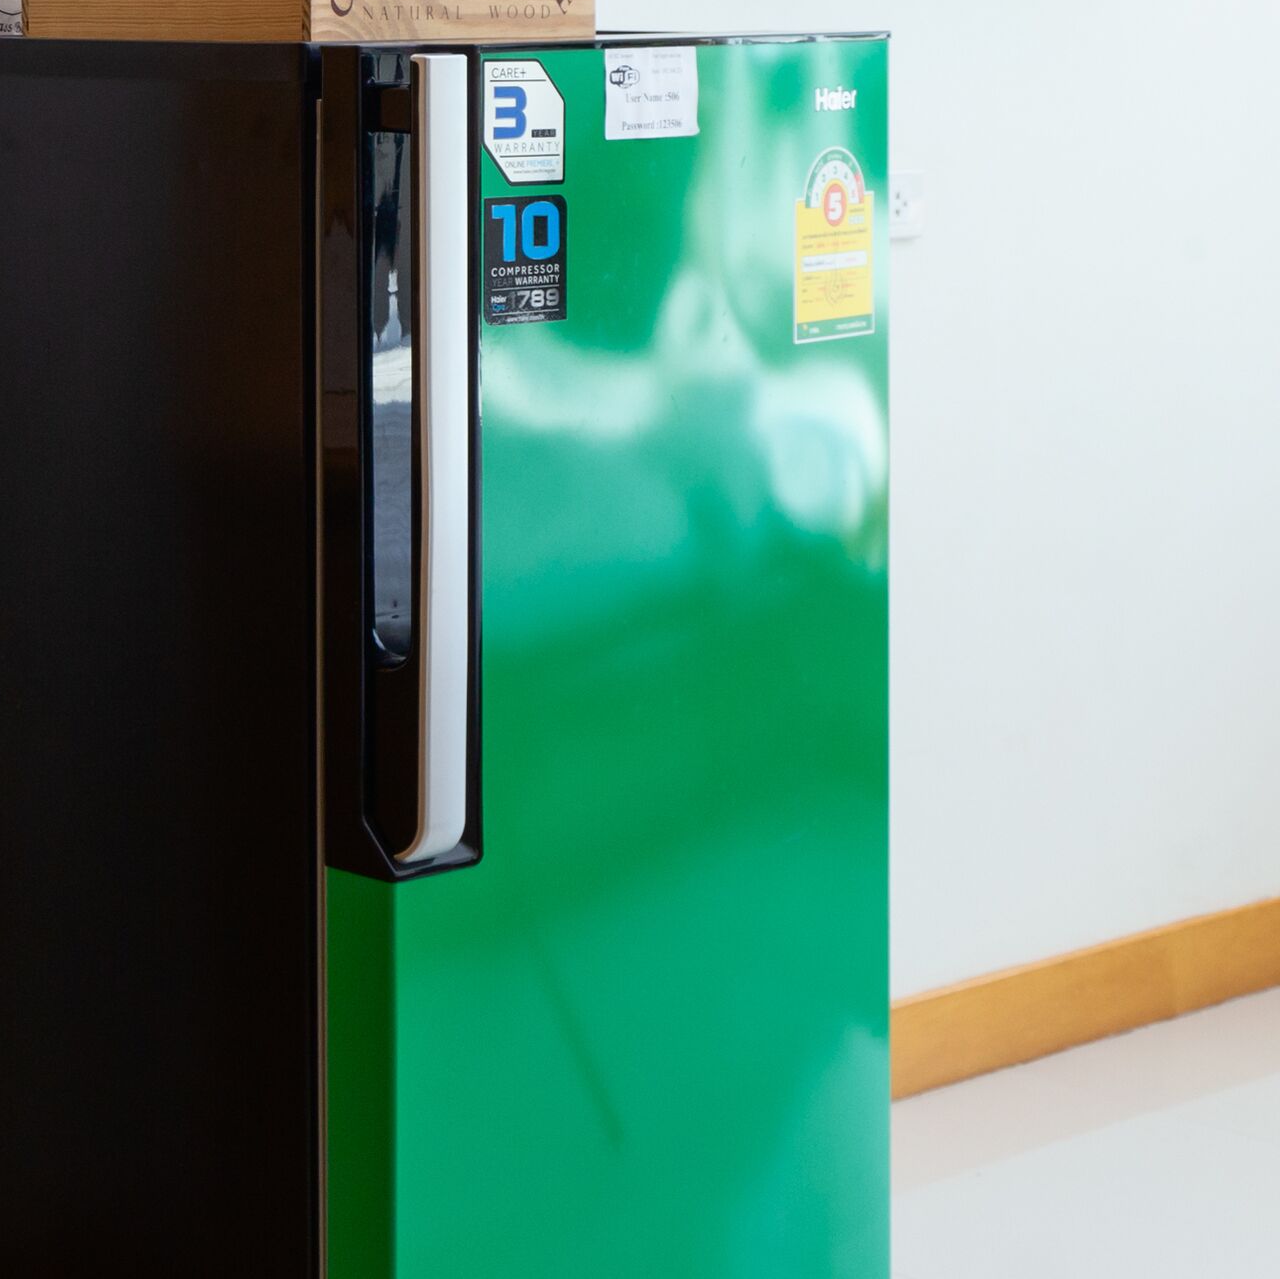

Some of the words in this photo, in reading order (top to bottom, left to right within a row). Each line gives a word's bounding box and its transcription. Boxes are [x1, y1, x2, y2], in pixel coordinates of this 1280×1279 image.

[362, 5, 464, 20] NATURAL
[489, 3, 551, 20] WOOD
[491, 67, 527, 79] CARE+
[815, 86, 857, 111] Haier
[493, 86, 527, 140] 3
[621, 120, 655, 131] Password
[495, 142, 560, 153] WARRANTY
[504, 160, 526, 169] ONLINE
[828, 191, 843, 221] 5
[491, 201, 560, 262] 10
[491, 263, 560, 277] COMPRESSOR
[514, 274, 560, 286] WARRANTY
